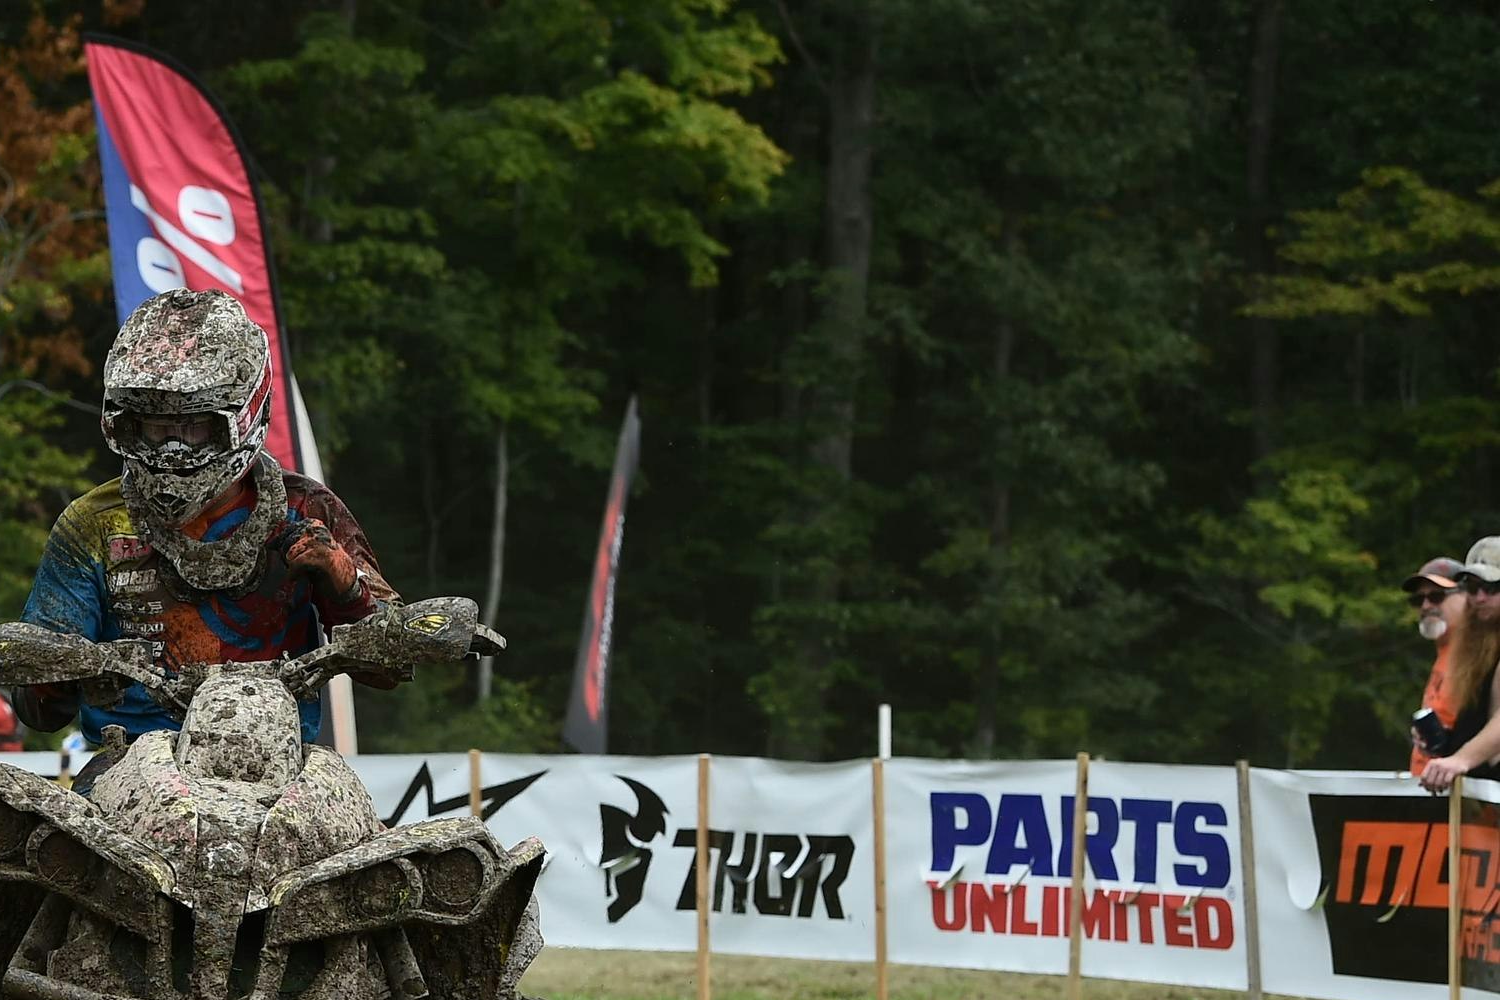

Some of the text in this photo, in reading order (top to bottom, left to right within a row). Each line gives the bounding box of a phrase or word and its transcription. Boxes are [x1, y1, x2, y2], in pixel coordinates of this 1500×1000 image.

[673, 829, 855, 919] THOR
[930, 792, 1231, 889] PARTS
[926, 880, 1234, 950] UNLIMITED
